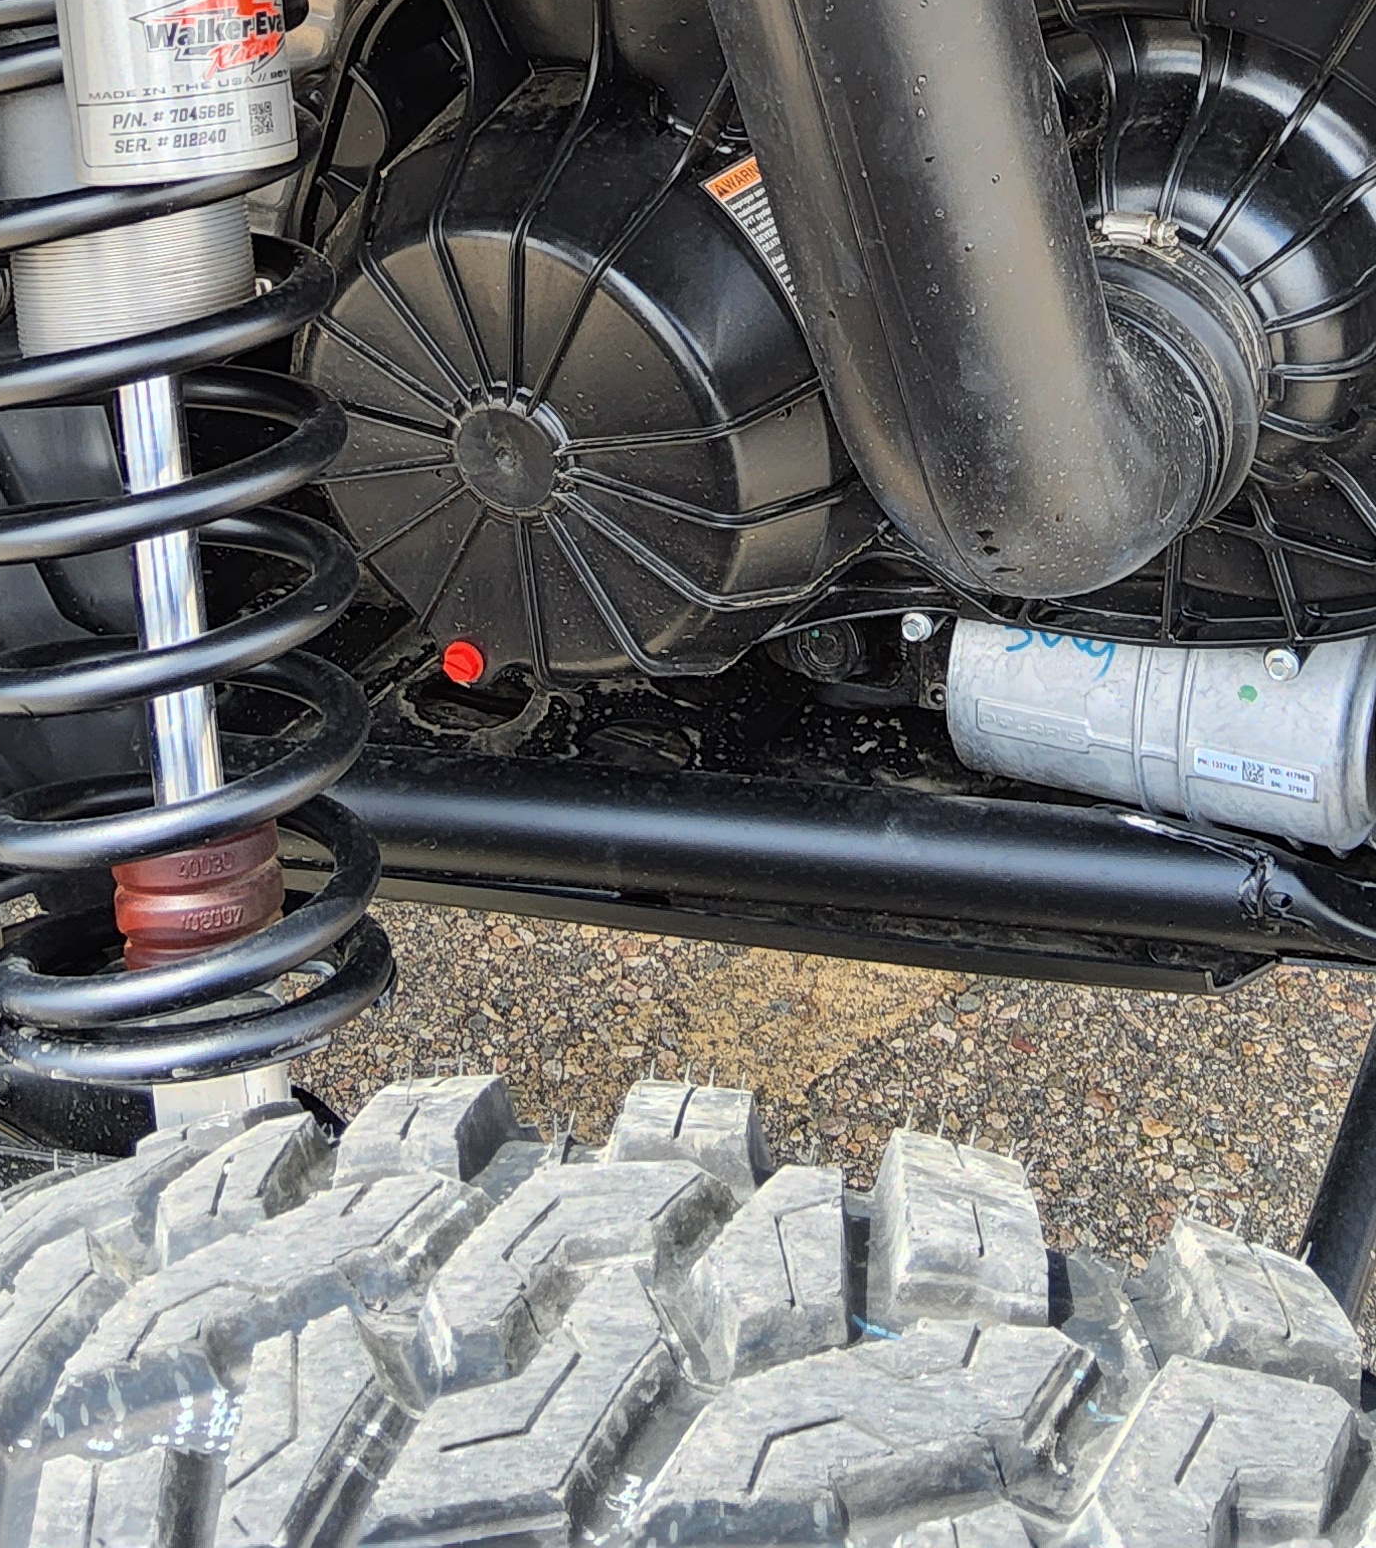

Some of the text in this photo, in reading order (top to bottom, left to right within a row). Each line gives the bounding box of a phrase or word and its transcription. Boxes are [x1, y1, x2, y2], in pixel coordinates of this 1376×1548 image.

[146, 17, 252, 49] Walker
[205, 32, 281, 80] Racing
[88, 89, 136, 101] MADE
[142, 86, 166, 97] IN
[172, 82, 211, 94] THE
[218, 75, 254, 88] USA
[112, 112, 147, 129] P/N.
[153, 111, 165, 122] #
[114, 138, 152, 154] SER.
[157, 136, 169, 147] #
[979, 711, 1086, 745] POLARIS
